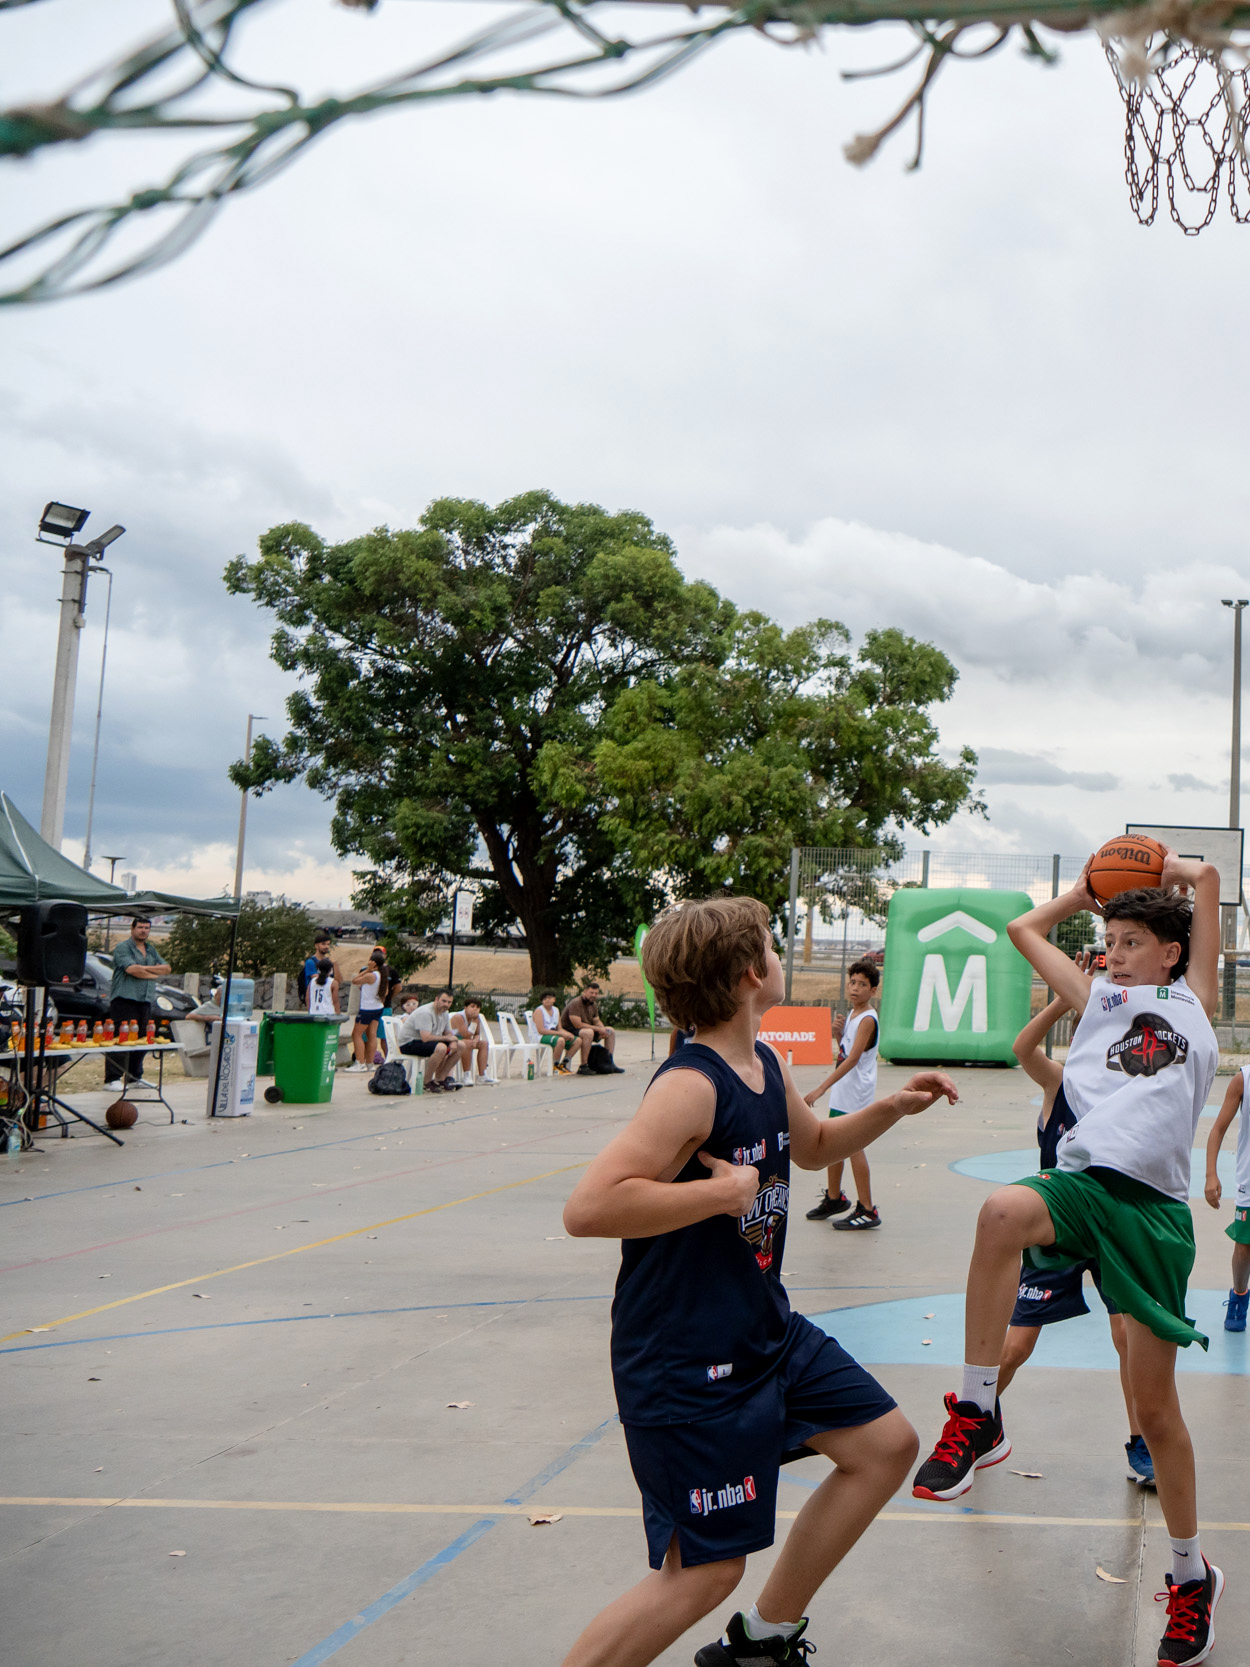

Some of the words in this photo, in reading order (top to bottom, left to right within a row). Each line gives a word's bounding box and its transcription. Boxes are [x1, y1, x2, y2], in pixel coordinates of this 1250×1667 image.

[1101, 847, 1151, 865] Wilson
[315, 989, 324, 1003] 15
[913, 953, 988, 1033] M
[1109, 1034, 1142, 1056] HOUSTON
[702, 1483, 745, 1516] jr.nba
